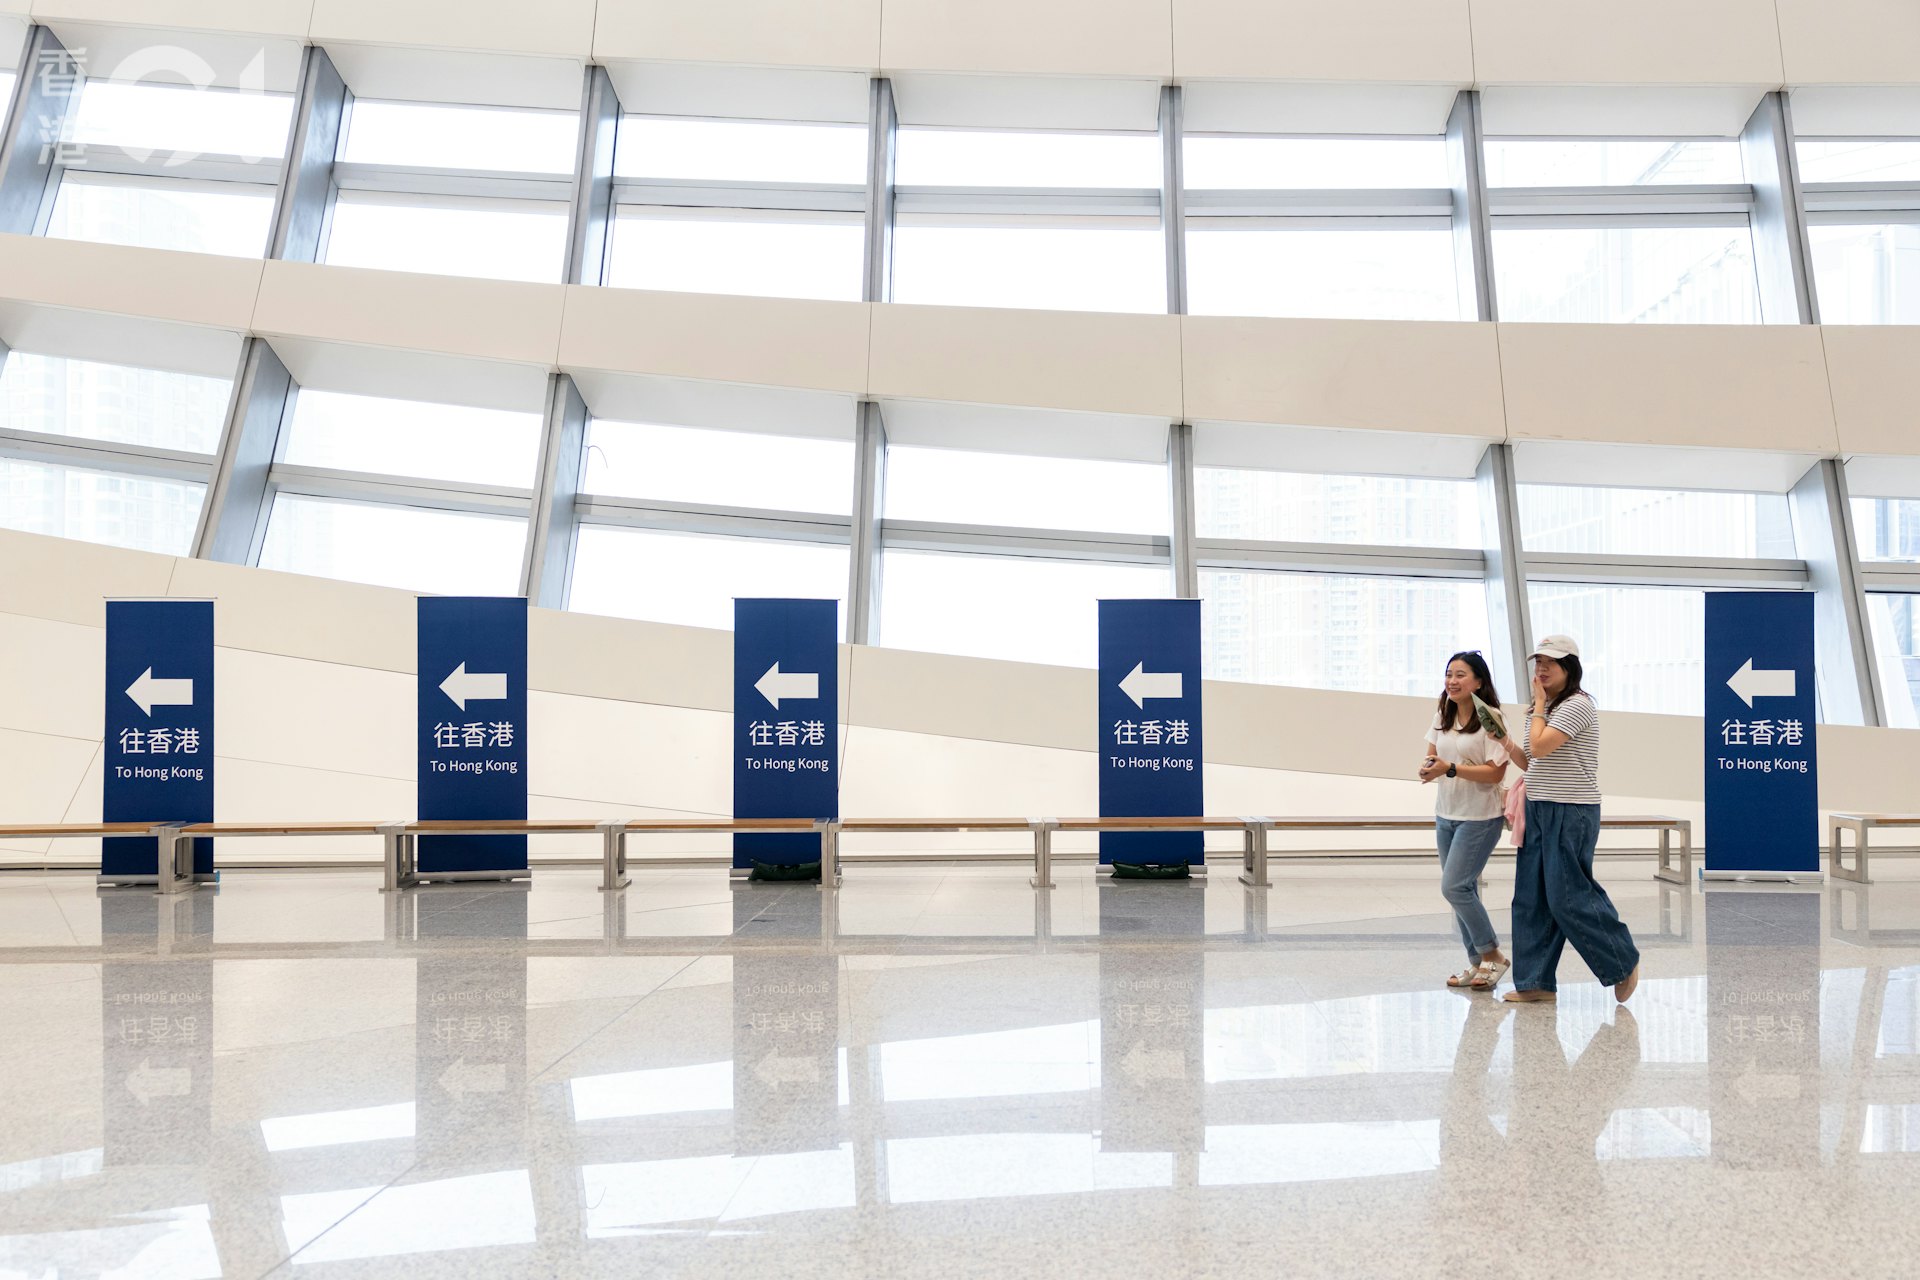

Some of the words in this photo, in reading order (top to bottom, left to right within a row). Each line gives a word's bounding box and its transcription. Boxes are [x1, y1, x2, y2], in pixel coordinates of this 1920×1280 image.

[119, 727, 200, 754] 往香港
[433, 721, 514, 749] 往香港
[748, 719, 826, 746] 往香港
[1113, 719, 1190, 745] 往香港
[1721, 718, 1804, 746] 往香港
[115, 766, 132, 778] To
[134, 766, 169, 781] Hong
[171, 766, 204, 781] Kong
[429, 760, 446, 773] To
[449, 759, 483, 775] Hong
[485, 759, 518, 774] Kong
[745, 758, 761, 770] To
[763, 757, 796, 773] Hong
[798, 757, 829, 772] Kong
[1110, 756, 1126, 769] To
[1128, 756, 1161, 772] Hong
[1162, 756, 1194, 771] Kong
[1717, 758, 1734, 770] To
[1737, 758, 1772, 773] Hong
[1774, 758, 1808, 773] Kong
